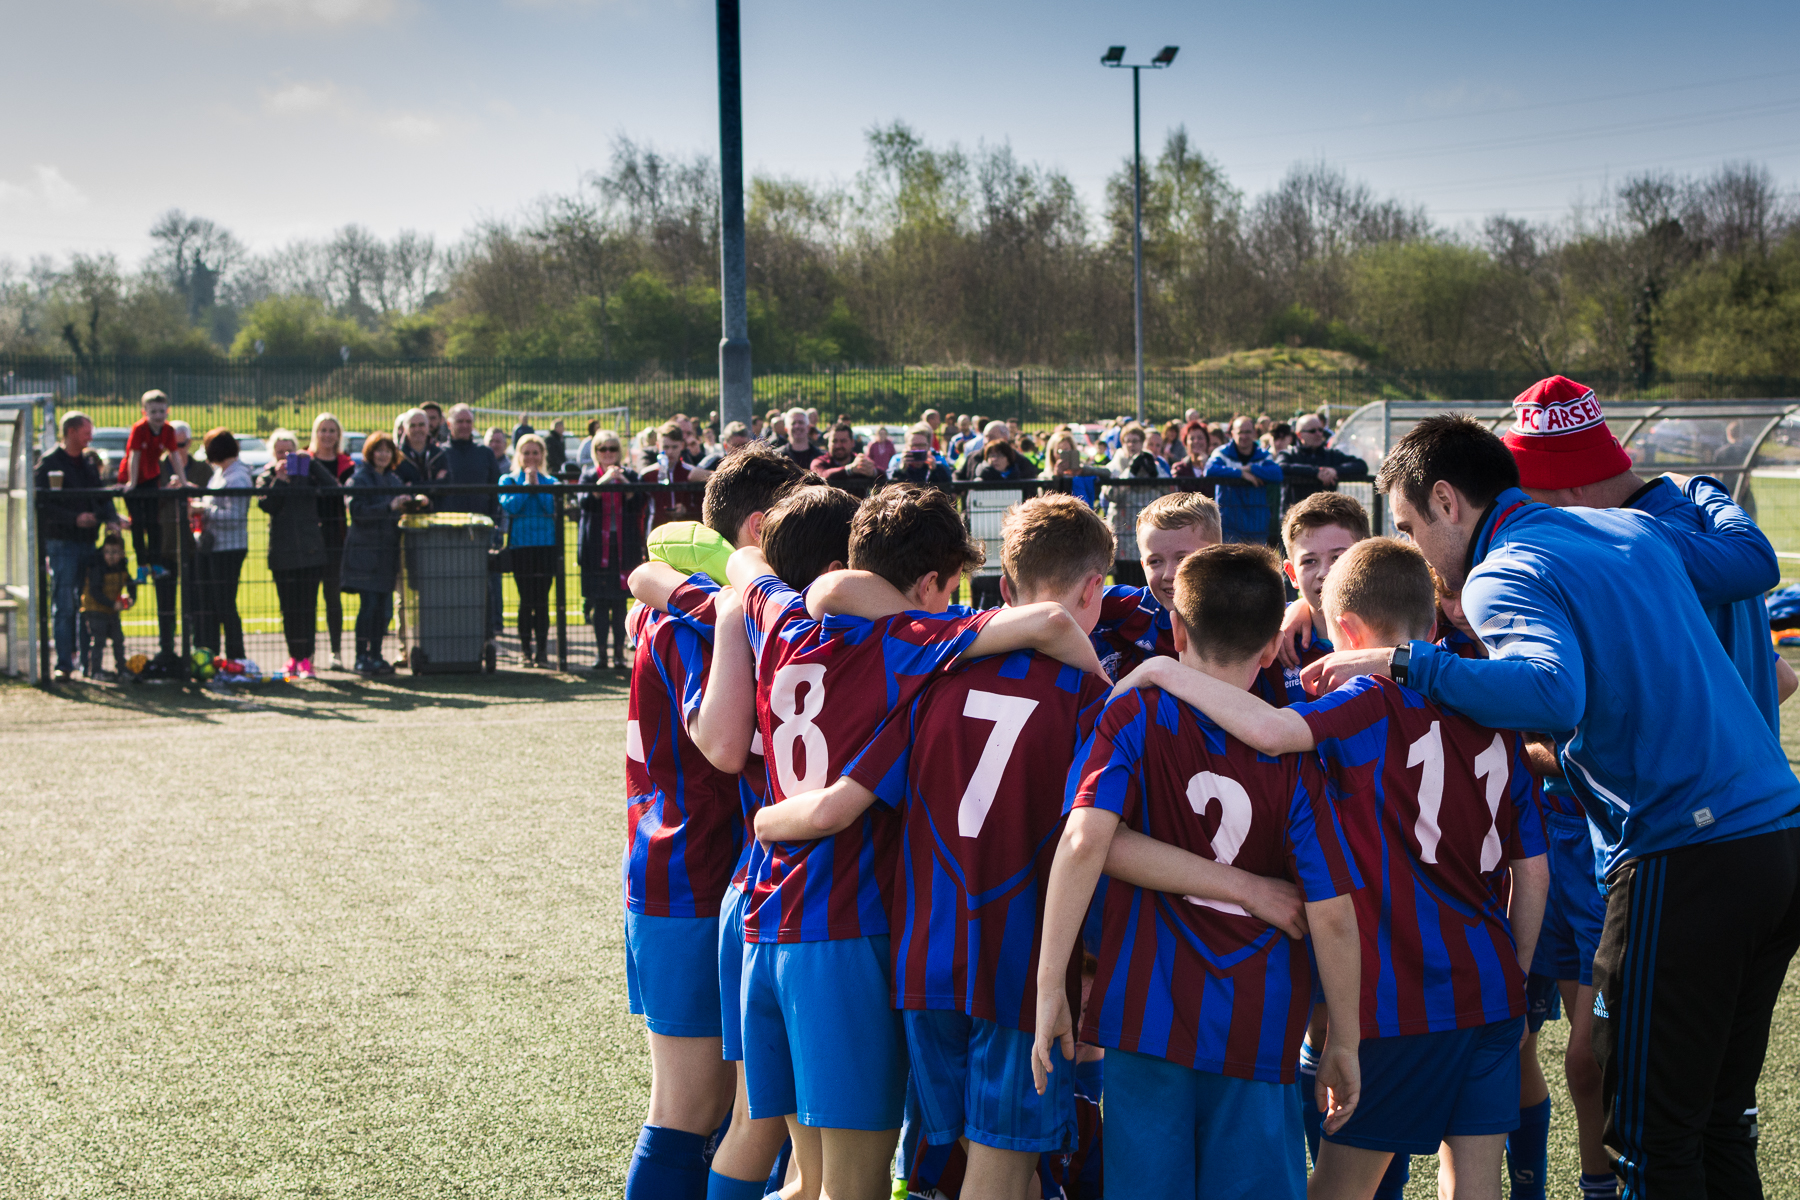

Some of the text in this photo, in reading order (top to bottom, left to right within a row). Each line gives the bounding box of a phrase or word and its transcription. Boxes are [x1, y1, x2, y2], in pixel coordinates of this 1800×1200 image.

[1521, 409, 1542, 430] FC
[770, 663, 828, 799] 8
[957, 689, 1040, 838] 7
[1406, 720, 1509, 874] 11
[1182, 771, 1253, 917] 2
